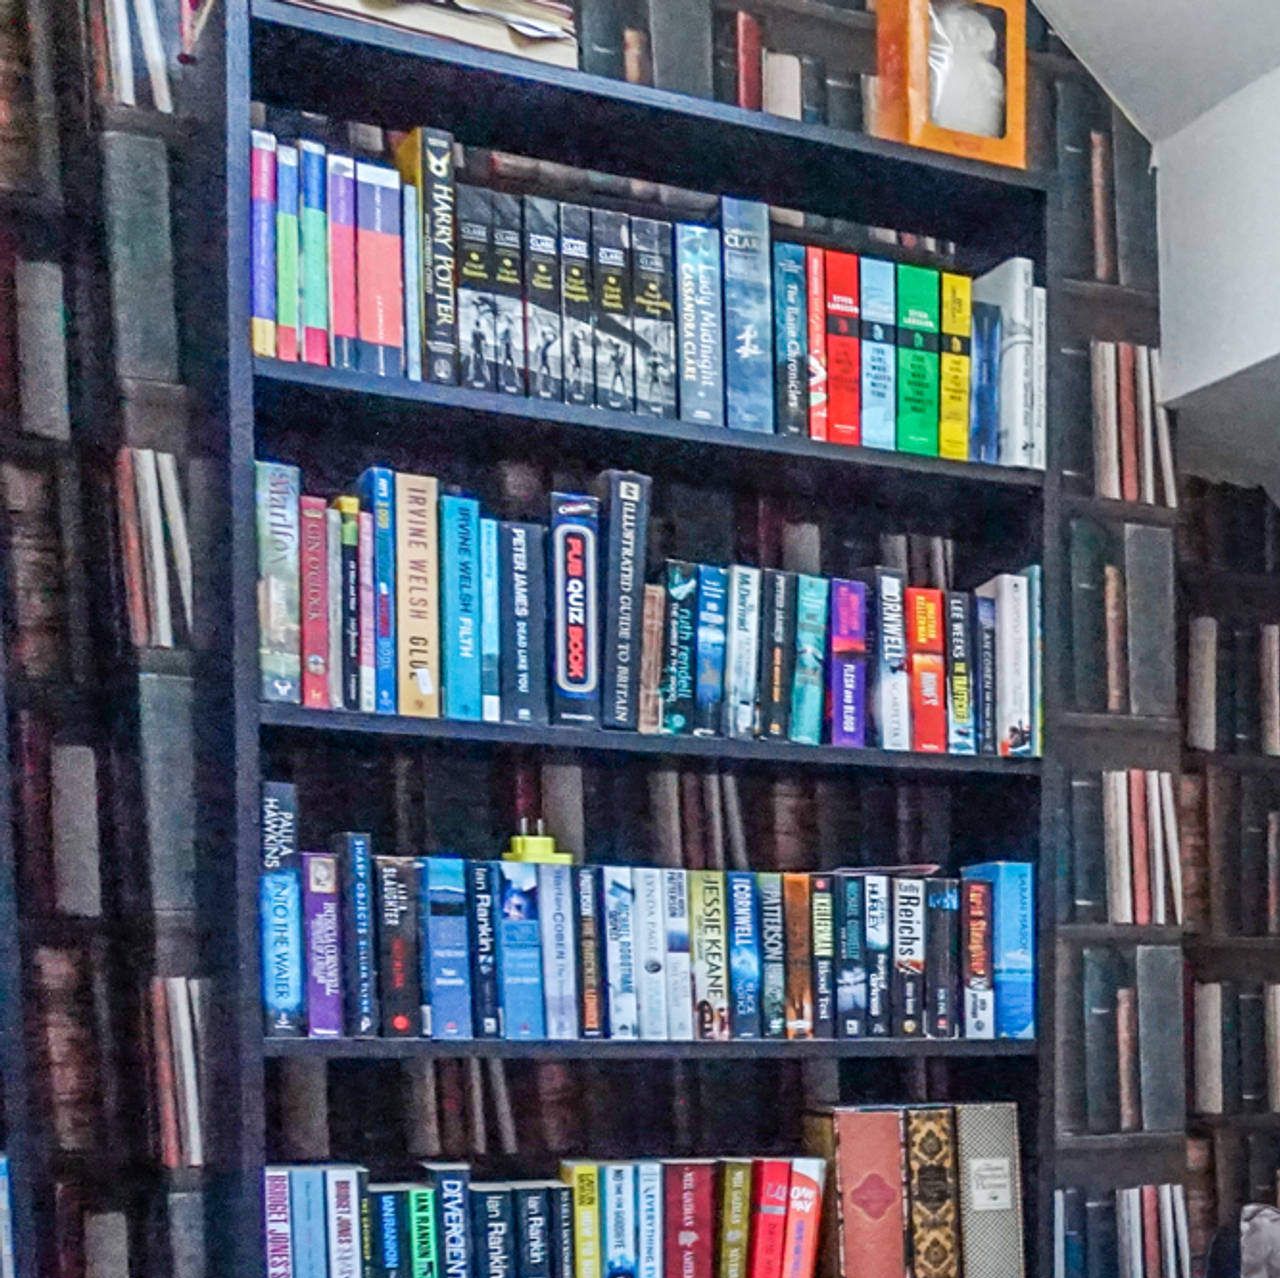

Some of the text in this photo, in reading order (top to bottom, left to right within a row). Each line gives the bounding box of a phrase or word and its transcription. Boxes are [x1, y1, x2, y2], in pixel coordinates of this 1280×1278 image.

[433, 184, 454, 325] HARRY POTTER
[682, 264, 696, 381] CASSANDRA CLARE
[696, 265, 718, 386] Lady Midnight
[787, 284, 799, 303] The
[788, 340, 802, 407] Chronicles
[268, 474, 296, 565] Marlfox
[307, 523, 320, 551] GIN
[407, 488, 429, 619] IRVINE WELSH
[458, 507, 473, 657] IRVINE WELSH FILTH
[512, 528, 529, 692] PETER JAMES DEAD LIKE YOU
[567, 538, 585, 678] PUB QUIZ BOOK
[615, 502, 635, 722] ILLUSTRATED GUIDE TO BRITAIN
[677, 608, 692, 699] ruth rendell
[881, 587, 904, 659] ORNWELL
[950, 600, 964, 658] LEE WEEKS
[843, 664, 855, 733] FLESH BLOOD
[264, 798, 280, 868] HAWKINS
[280, 812, 293, 856] PAULA
[354, 840, 367, 934] SHARP OBJECTS
[383, 868, 398, 926] SLAUGHTER
[476, 868, 493, 952] Ian Rankin
[644, 874, 658, 953] LYNDA PAGE
[733, 883, 754, 945] CORNWELL
[868, 883, 879, 931] HURLEY
[275, 923, 289, 947] THE
[553, 912, 566, 960] COBEN
[702, 879, 724, 999] JESSIE KEANE
[763, 890, 783, 960] PATTERSON
[813, 898, 833, 1019] KELLERMAN Blood Test
[898, 896, 923, 956] Reichs
[276, 952, 289, 999] WATER
[746, 982, 755, 1013] BLACK
[267, 1175, 288, 1223] BRIDGET
[335, 1180, 351, 1244] BRIDGET JONES
[486, 1195, 503, 1218] Ian
[613, 1169, 625, 1249] NO GOODBYE
[684, 1172, 694, 1190] NEIL
[380, 1195, 398, 1268] IAN RANKIN
[414, 1192, 431, 1258] IAN RANKIN
[527, 1196, 545, 1263] Ian Rankin
[646, 1194, 654, 1263] EVERYTHING
